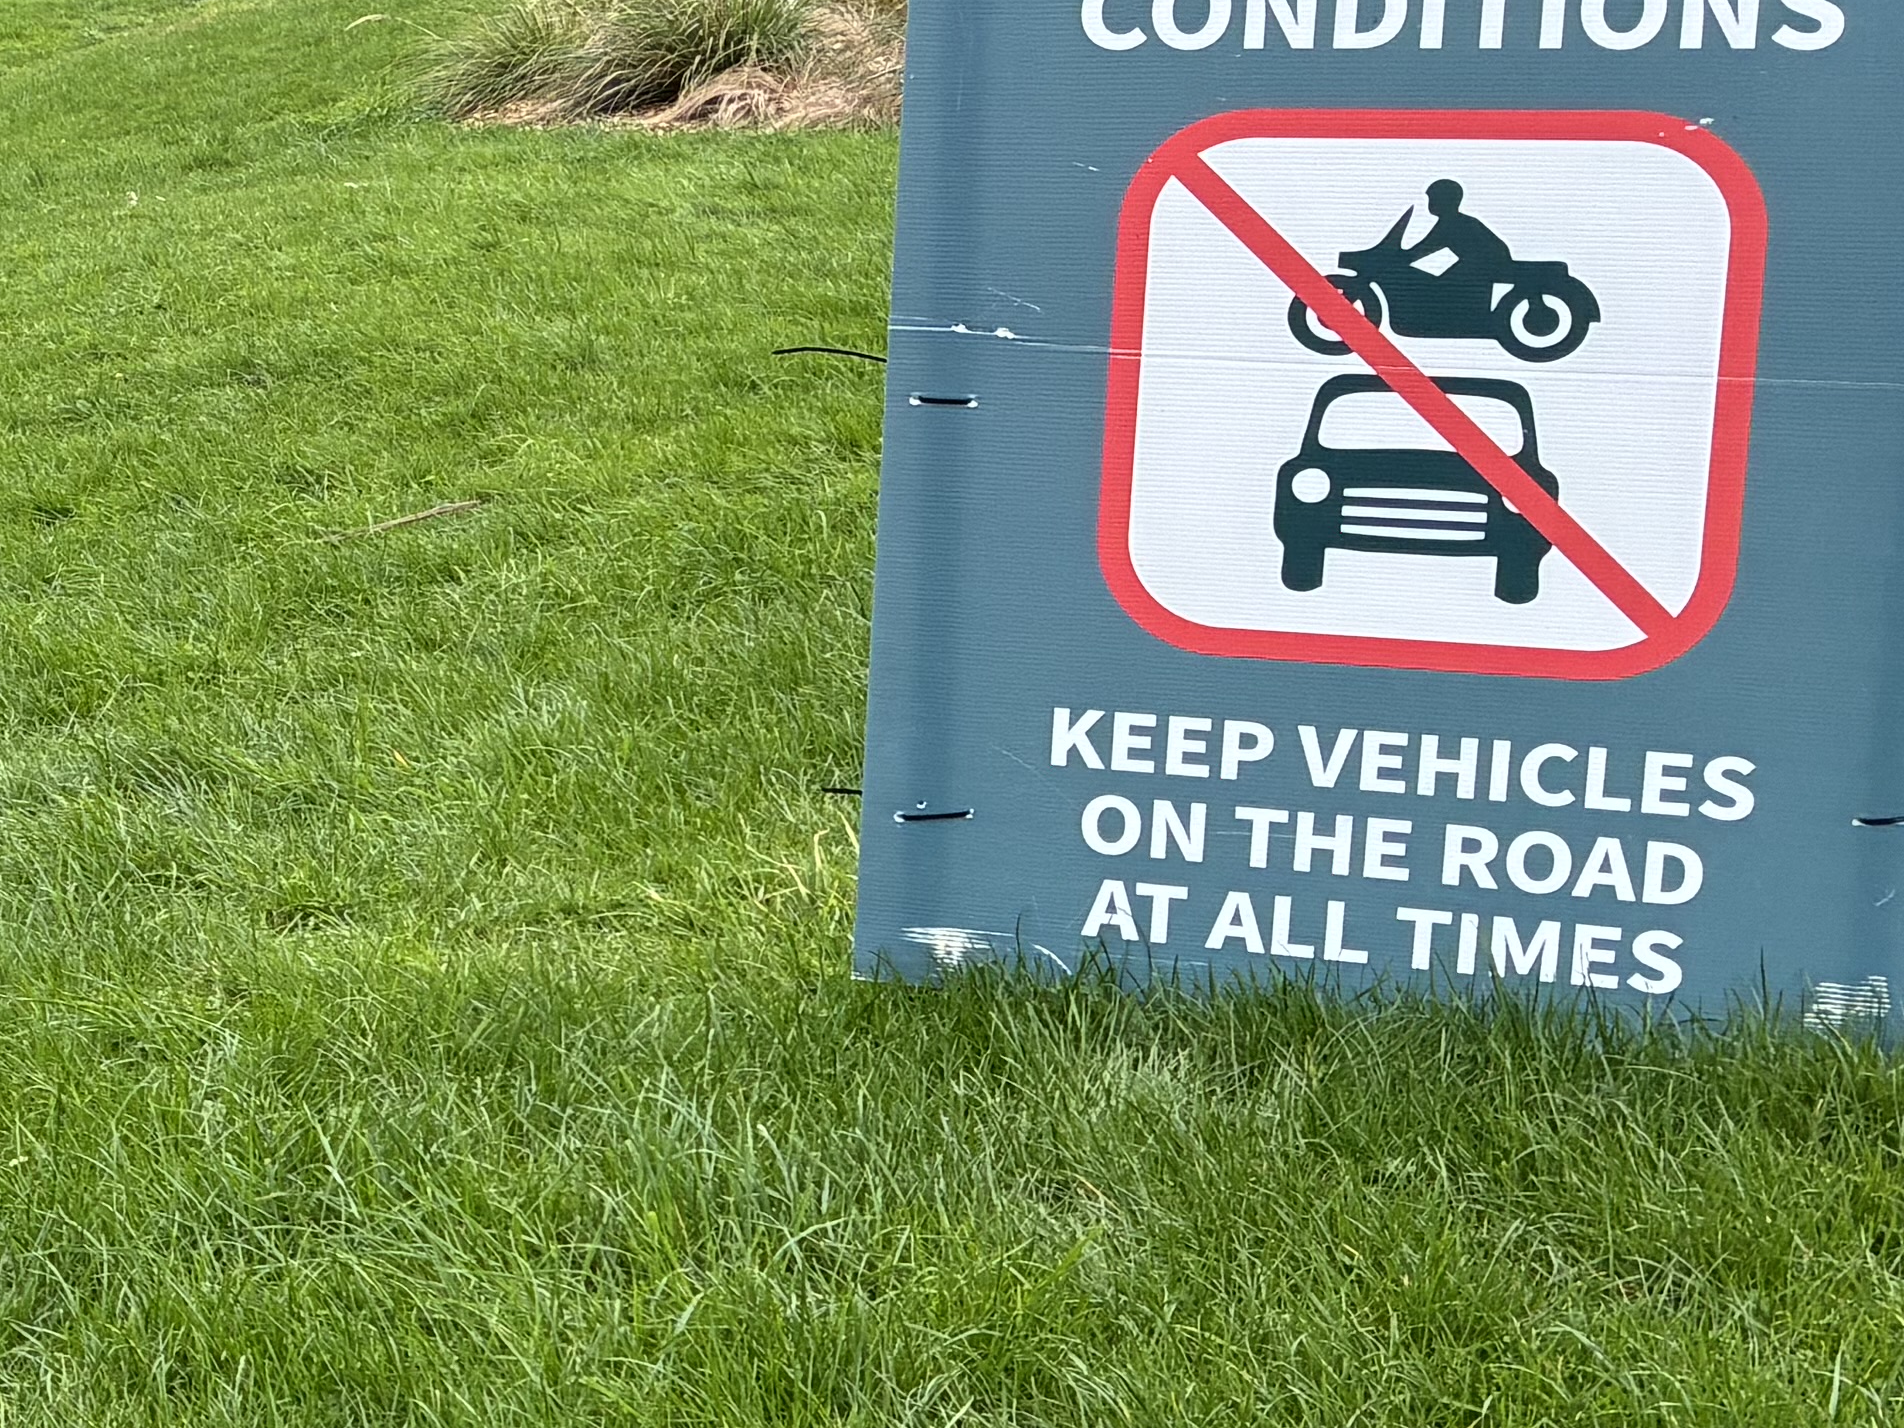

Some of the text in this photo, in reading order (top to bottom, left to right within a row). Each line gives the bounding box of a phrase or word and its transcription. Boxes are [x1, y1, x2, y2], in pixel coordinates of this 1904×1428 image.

[1050, 707, 1756, 821] KEEP VEHICLES
[1081, 794, 1704, 905] ON THE ROAD
[1080, 879, 1684, 995] AT ALL TIMES
